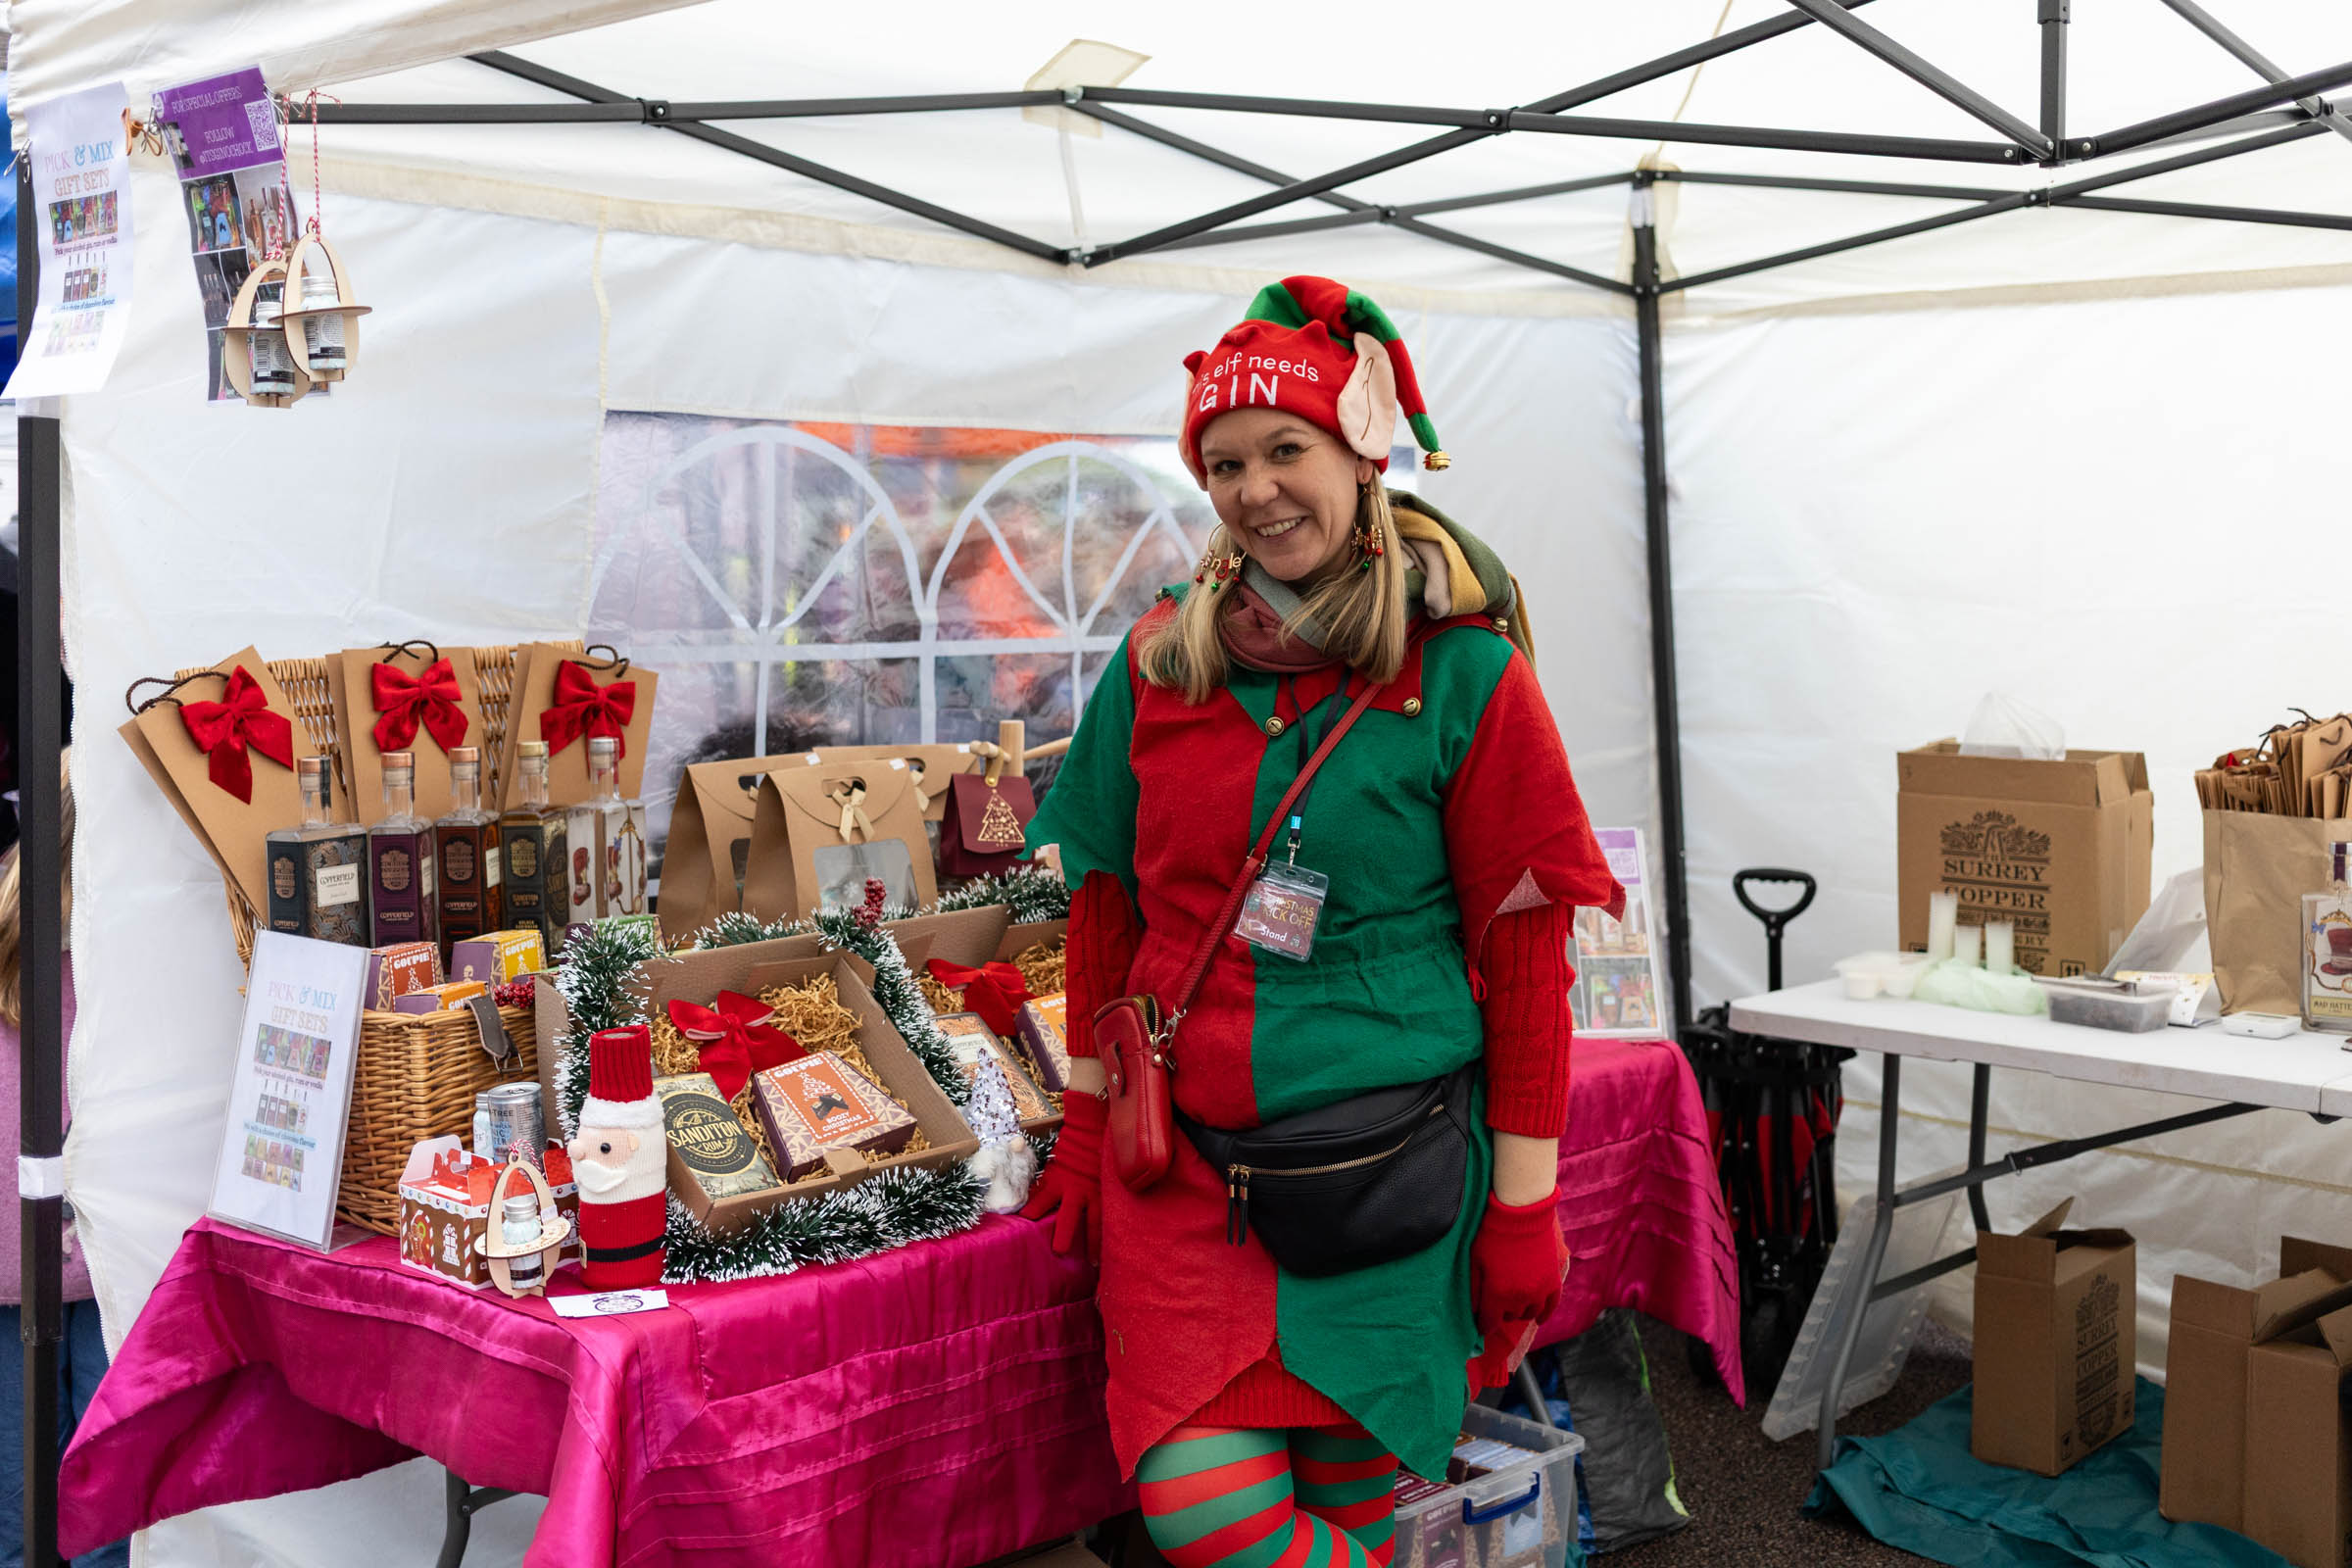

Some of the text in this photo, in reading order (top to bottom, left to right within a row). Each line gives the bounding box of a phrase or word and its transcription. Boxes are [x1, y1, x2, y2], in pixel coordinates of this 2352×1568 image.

[184, 92, 216, 112] SPECIAL
[213, 85, 243, 104] OFFERS
[204, 126, 236, 144] FOLLOW
[44, 140, 115, 172] PICK & MIX
[54, 167, 111, 197] GIFT SETS
[1213, 352, 1243, 378] elf
[1248, 356, 1319, 382] needs
[1199, 372, 1279, 412] GIN
[1943, 858, 2047, 882] SURREY
[1260, 925, 1288, 942] Stand
[1289, 912, 1313, 930] OFF
[267, 980, 337, 1012] PICK & MIX
[271, 1004, 329, 1035] GIFT SETS
[822, 1113, 863, 1132] CHRISTMAS
[825, 1111, 850, 1124] BOOZY
[665, 1120, 744, 1149] SANDITON
[702, 1139, 725, 1152] RUM
[2077, 1316, 2118, 1351] SURREY
[2077, 1340, 2118, 1376] COPPER
